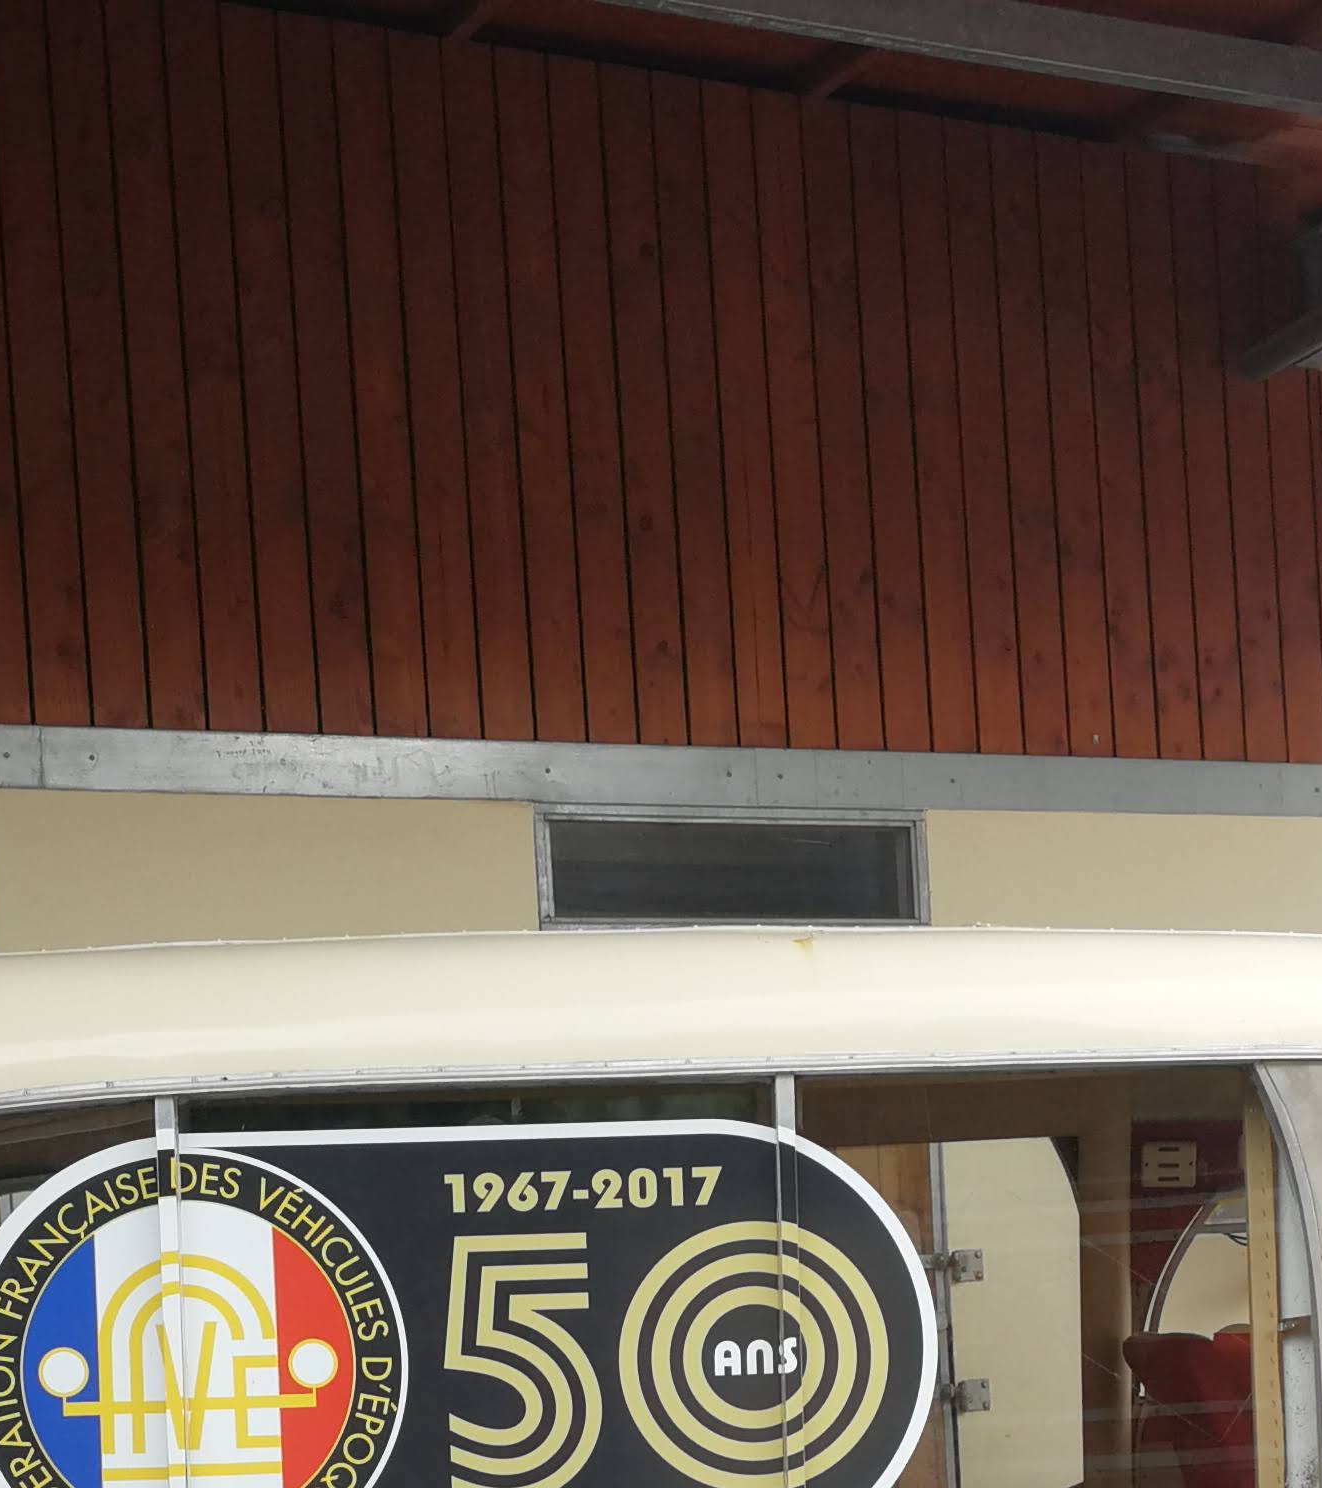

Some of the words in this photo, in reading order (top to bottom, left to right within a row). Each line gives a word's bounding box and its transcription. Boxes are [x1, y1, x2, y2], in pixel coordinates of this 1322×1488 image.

[444, 1165, 723, 1213] 1967-2017
[170, 1156, 242, 1199] DES
[259, 1175, 389, 1342] VÉHICULES
